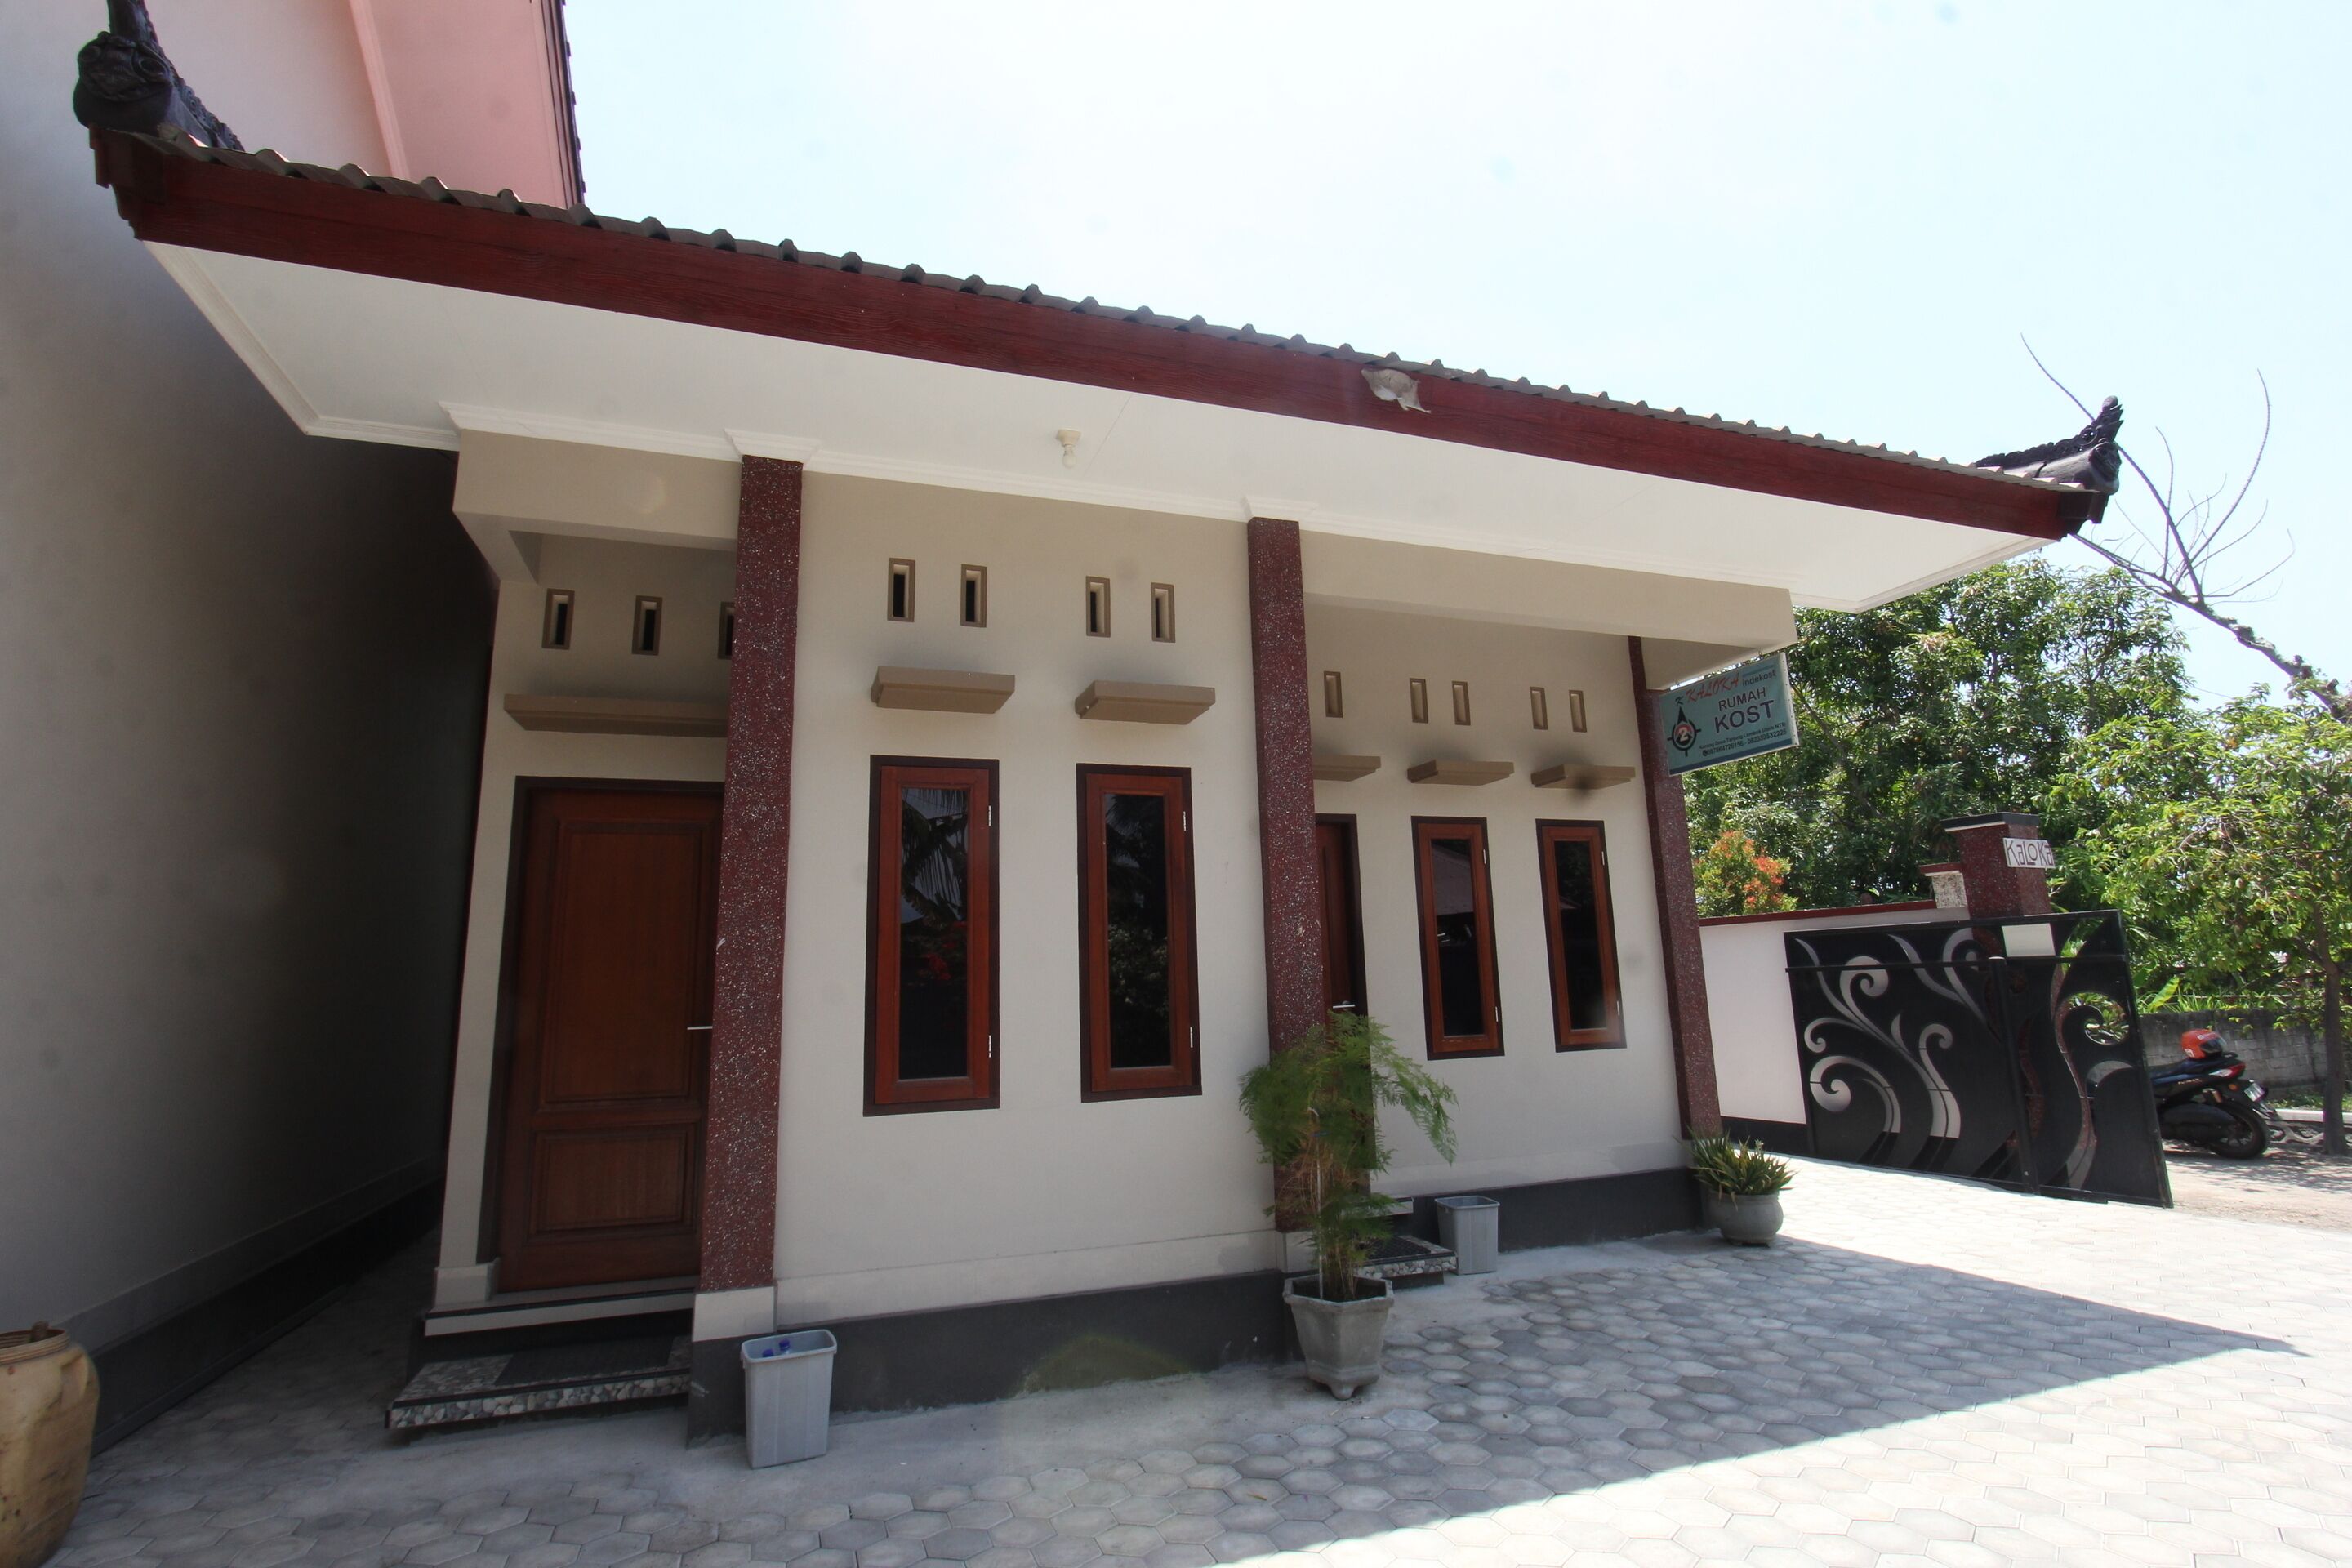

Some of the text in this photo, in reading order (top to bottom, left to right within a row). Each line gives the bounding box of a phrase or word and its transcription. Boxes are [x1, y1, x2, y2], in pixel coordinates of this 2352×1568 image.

[1743, 670, 1775, 686] indekost
[1718, 687, 1766, 710] RUMAH
[1715, 700, 1774, 733] KOST
